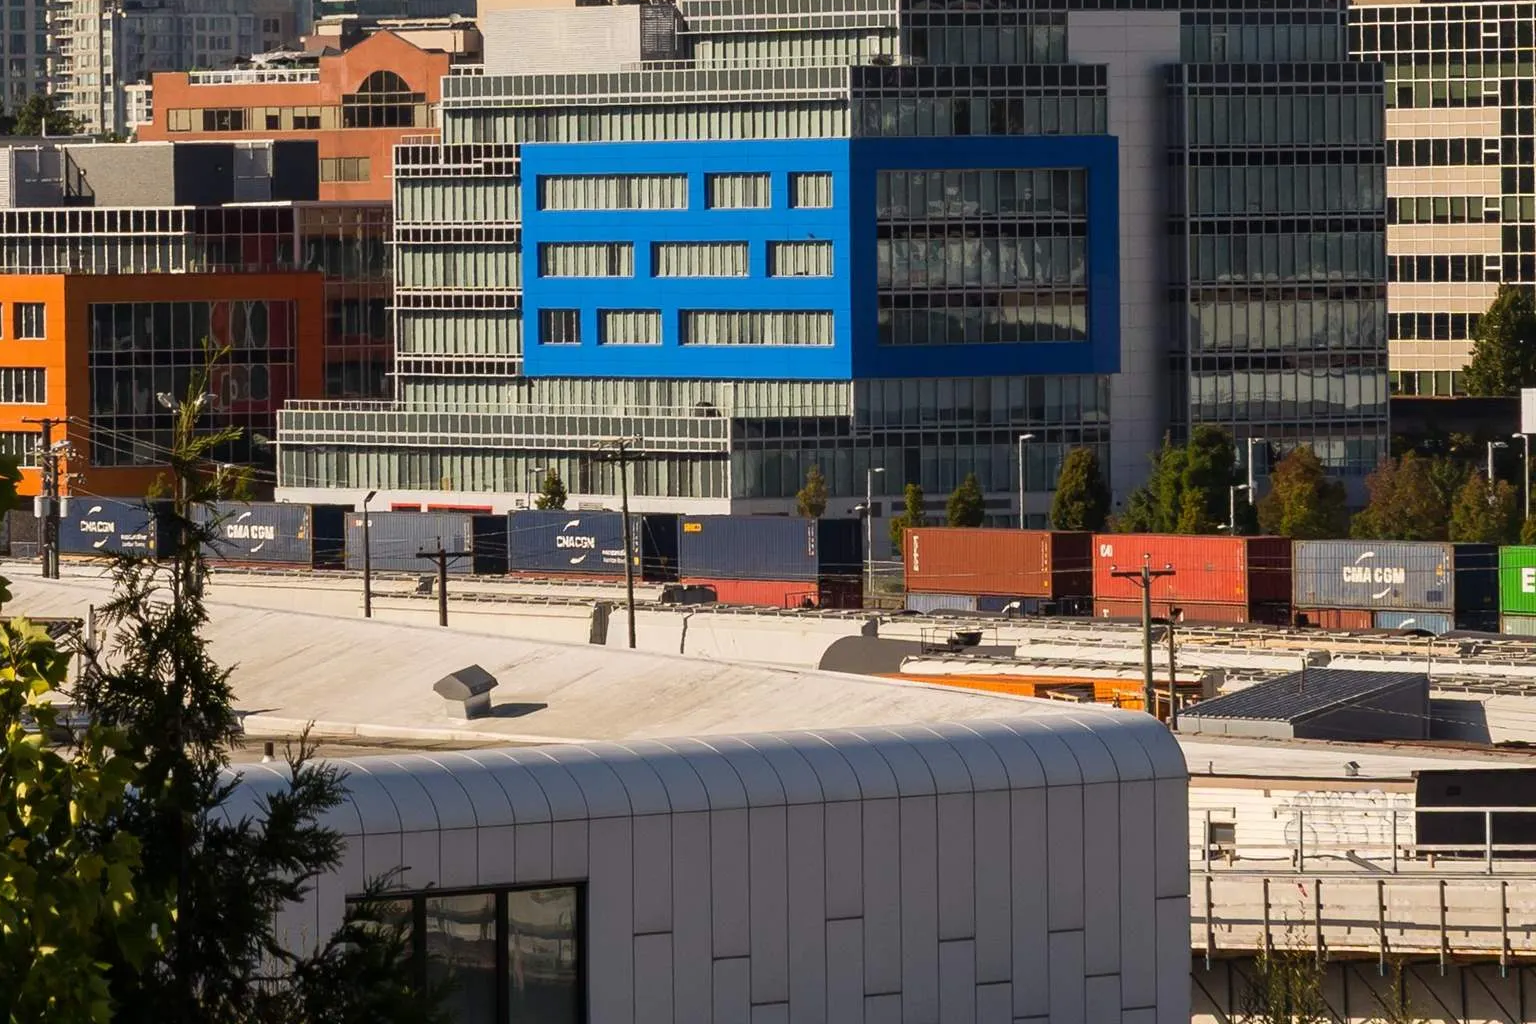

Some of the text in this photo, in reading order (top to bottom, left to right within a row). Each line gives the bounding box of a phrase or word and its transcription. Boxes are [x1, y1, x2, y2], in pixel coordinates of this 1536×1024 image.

[227, 524, 274, 540] CMA CGM
[1344, 567, 1405, 584] CMA CGM
